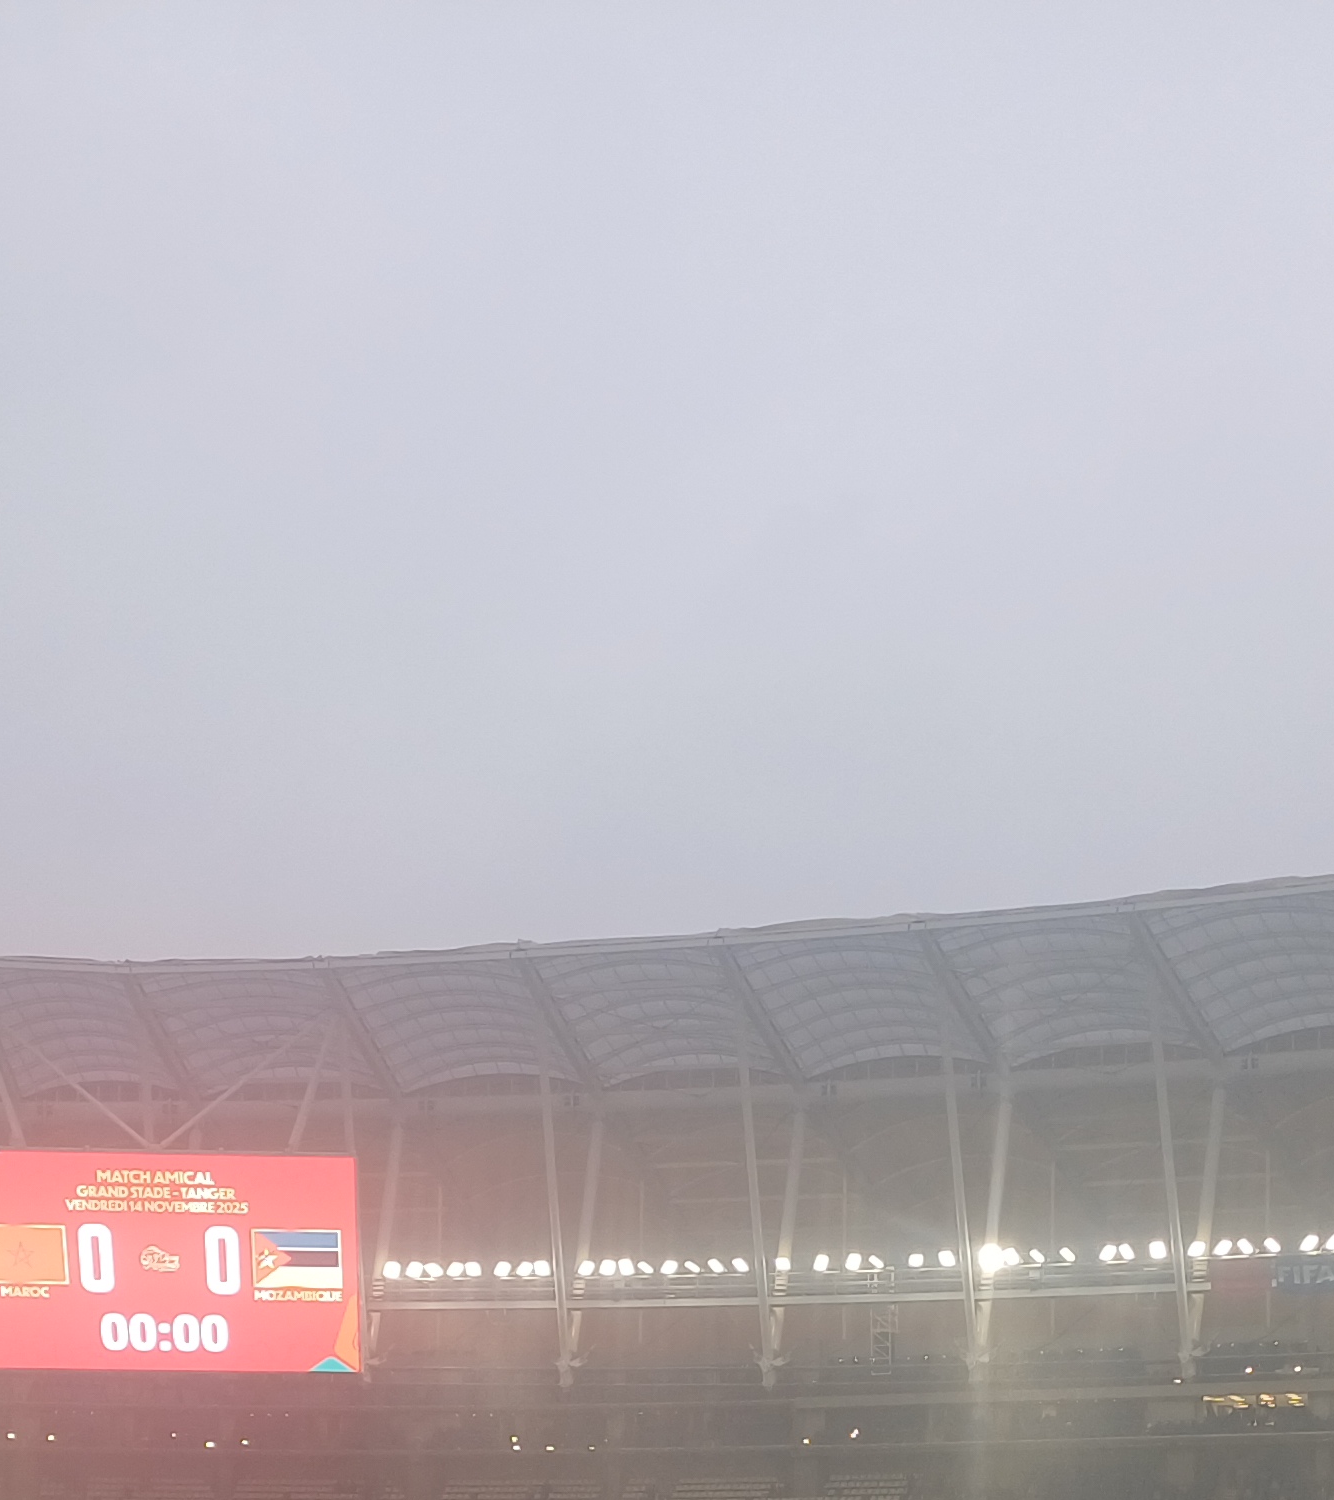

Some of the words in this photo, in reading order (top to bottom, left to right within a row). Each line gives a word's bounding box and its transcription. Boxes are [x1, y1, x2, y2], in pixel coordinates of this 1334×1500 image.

[96, 1169, 151, 1184] MATCH
[153, 1170, 215, 1186] AMICAL
[76, 1185, 129, 1198] GRAND
[130, 1186, 171, 1199] STADE
[180, 1187, 237, 1200] TANGER
[64, 1199, 128, 1212] VENDREDI
[129, 1200, 143, 1213] 14
[144, 1201, 215, 1214] NOVEMBRE
[216, 1202, 249, 1215] 2025
[77, 1223, 115, 1293] 0
[204, 1225, 241, 1295] 0
[0, 1285, 51, 1299] MAROC
[253, 1289, 343, 1302] MOZAMBIQUE
[100, 1312, 229, 1353] 00:00
